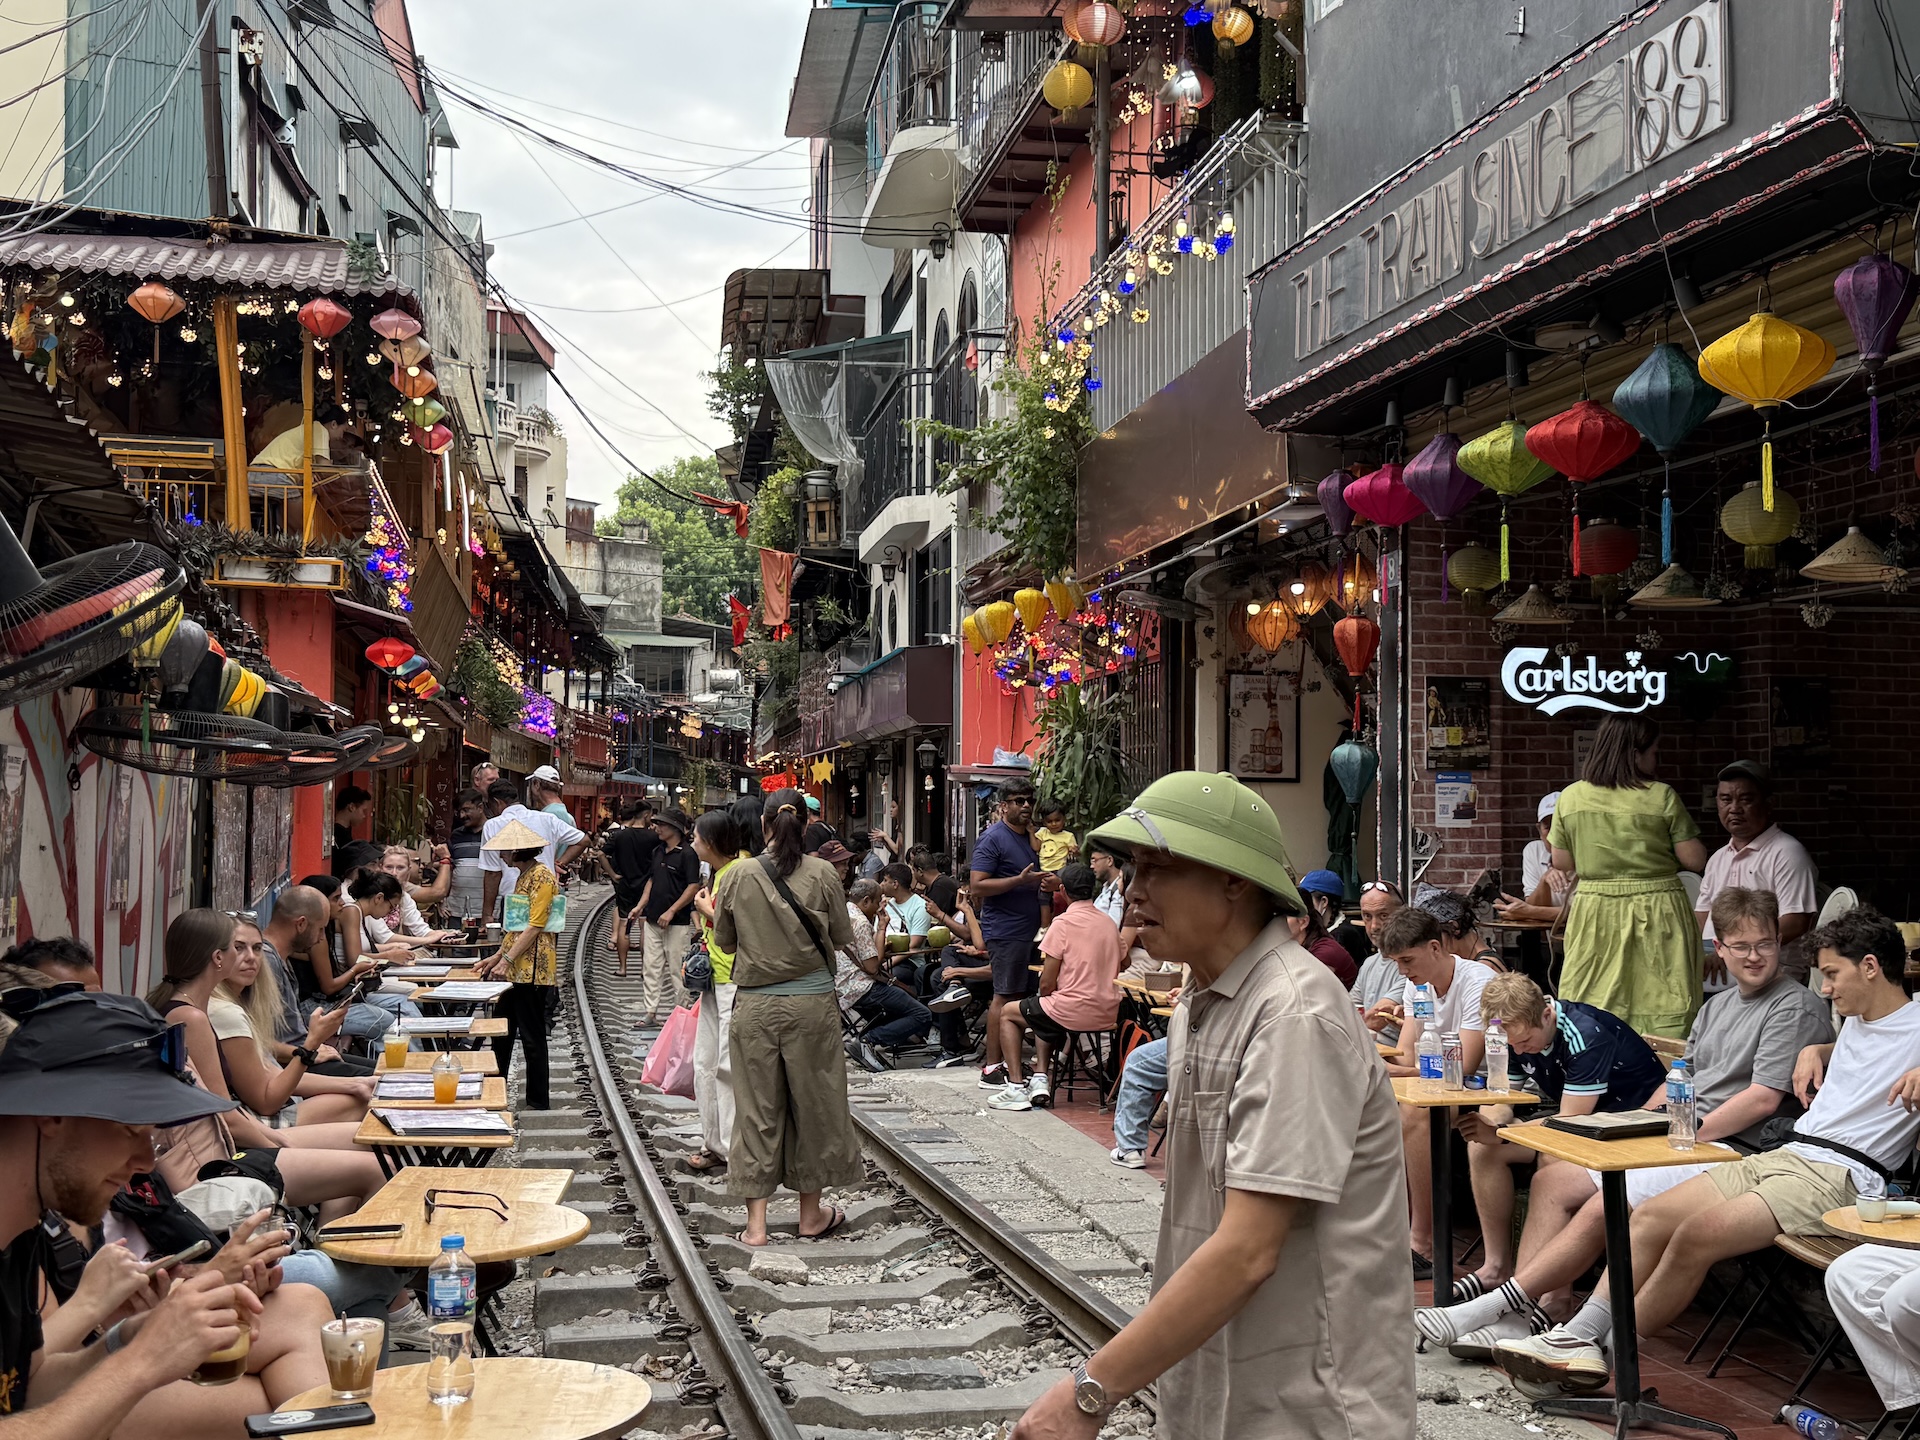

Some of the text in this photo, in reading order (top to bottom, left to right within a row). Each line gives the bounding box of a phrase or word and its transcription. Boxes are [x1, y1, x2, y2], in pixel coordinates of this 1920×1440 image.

[1289, 245, 1346, 360] THE
[1357, 165, 1464, 321] TRAIN
[1469, 79, 1595, 256] SINCE
[1500, 646, 1668, 717] Carlsberg
